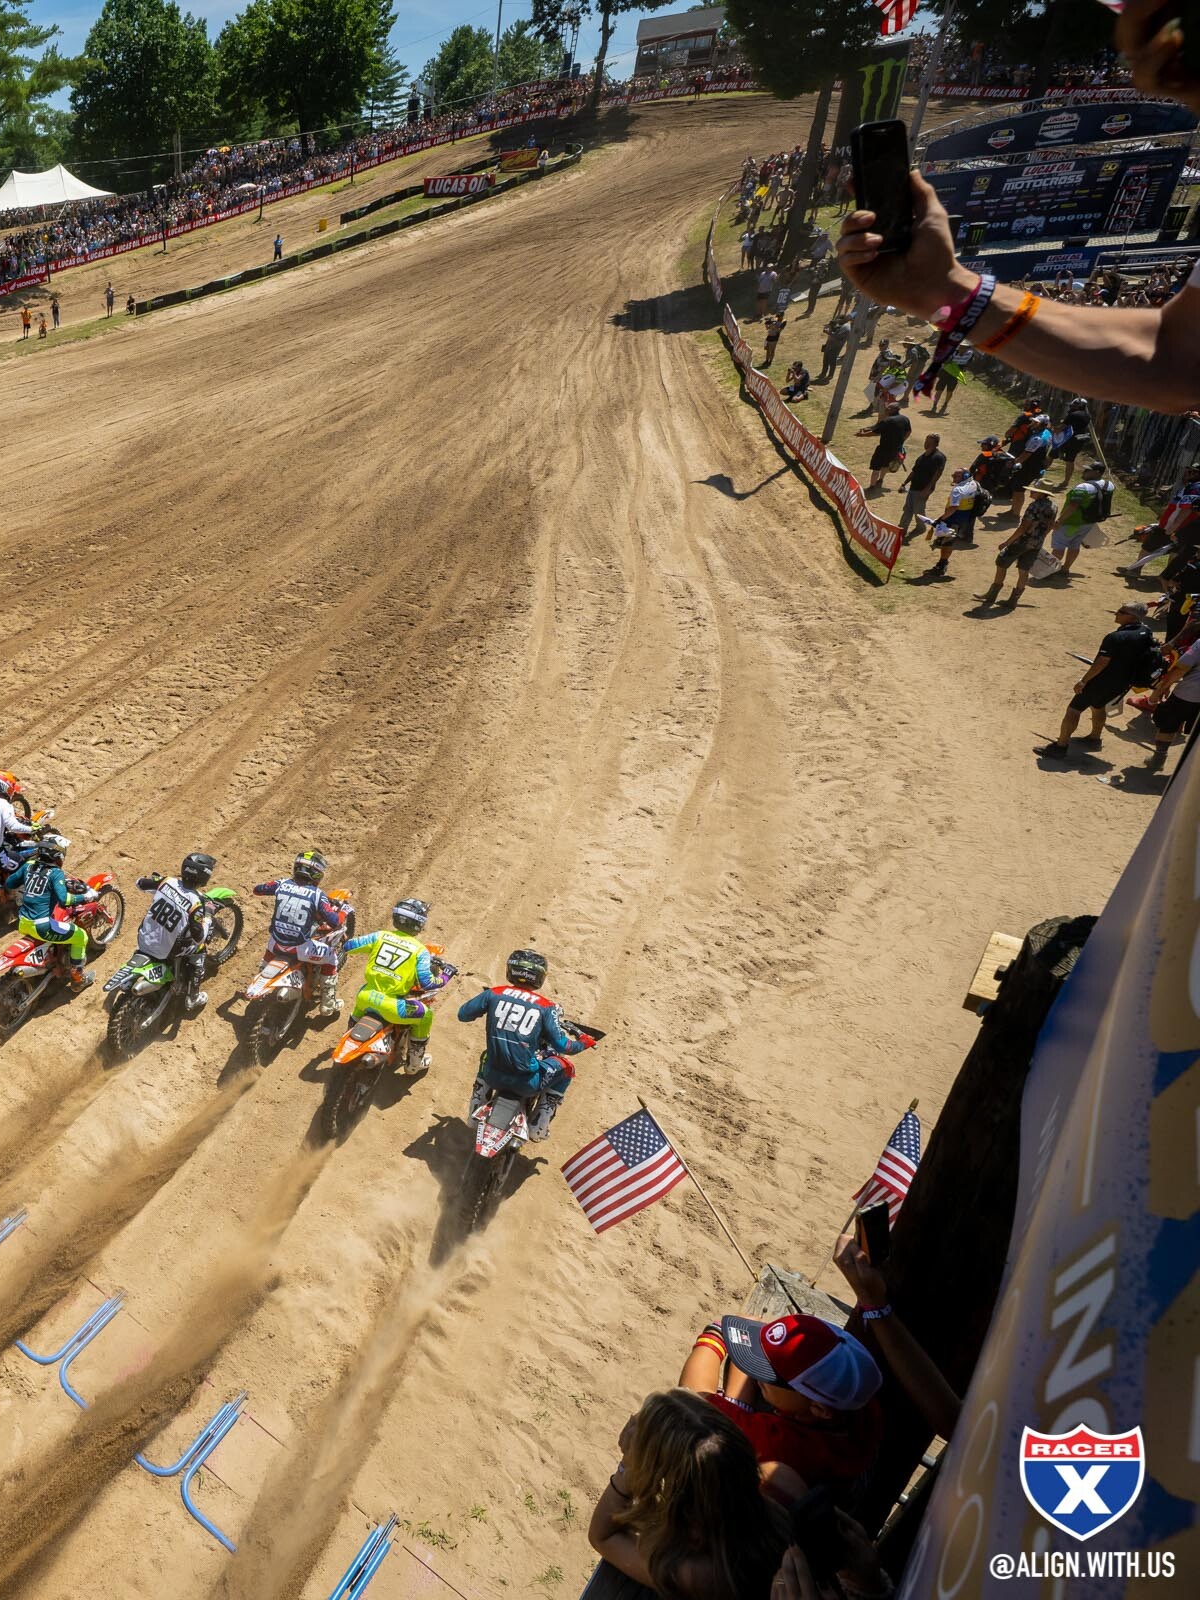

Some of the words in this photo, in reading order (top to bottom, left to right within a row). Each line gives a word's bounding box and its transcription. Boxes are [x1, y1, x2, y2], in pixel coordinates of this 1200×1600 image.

[947, 86, 968, 96] LUCAS
[968, 87, 984, 96] OIL
[983, 88, 1003, 98] LUCAS
[1004, 89, 1021, 98] OIL
[494, 119, 512, 128] LUCAS
[462, 126, 480, 136] LUCAS
[433, 135, 450, 145] LUCAS
[406, 143, 422, 154] LUCAS
[380, 152, 394, 162] LUCAS
[1024, 164, 1054, 176] LUCAS
[1056, 162, 1074, 172] OIL
[428, 178, 467, 194] LUCAS
[1002, 175, 1084, 191] MOTOCROSS
[88, 251, 104, 261] LUCAS
[58, 258, 76, 269] LUCAS
[1033, 260, 1090, 272] MOTOCROSS
[27, 266, 46, 276] LUCAS
[16, 277, 41, 288] HONDA
[800, 437, 822, 471] LUCAS
[818, 457, 832, 481] OIL
[851, 504, 878, 545] LUCAS
[876, 528, 896, 558] OIL
[280, 884, 316, 898] SCHMIDT
[150, 898, 183, 933] 489
[276, 894, 311, 926] 746
[376, 944, 412, 970] 57
[148, 966, 163, 982] 489
[495, 1000, 540, 1036] 420
